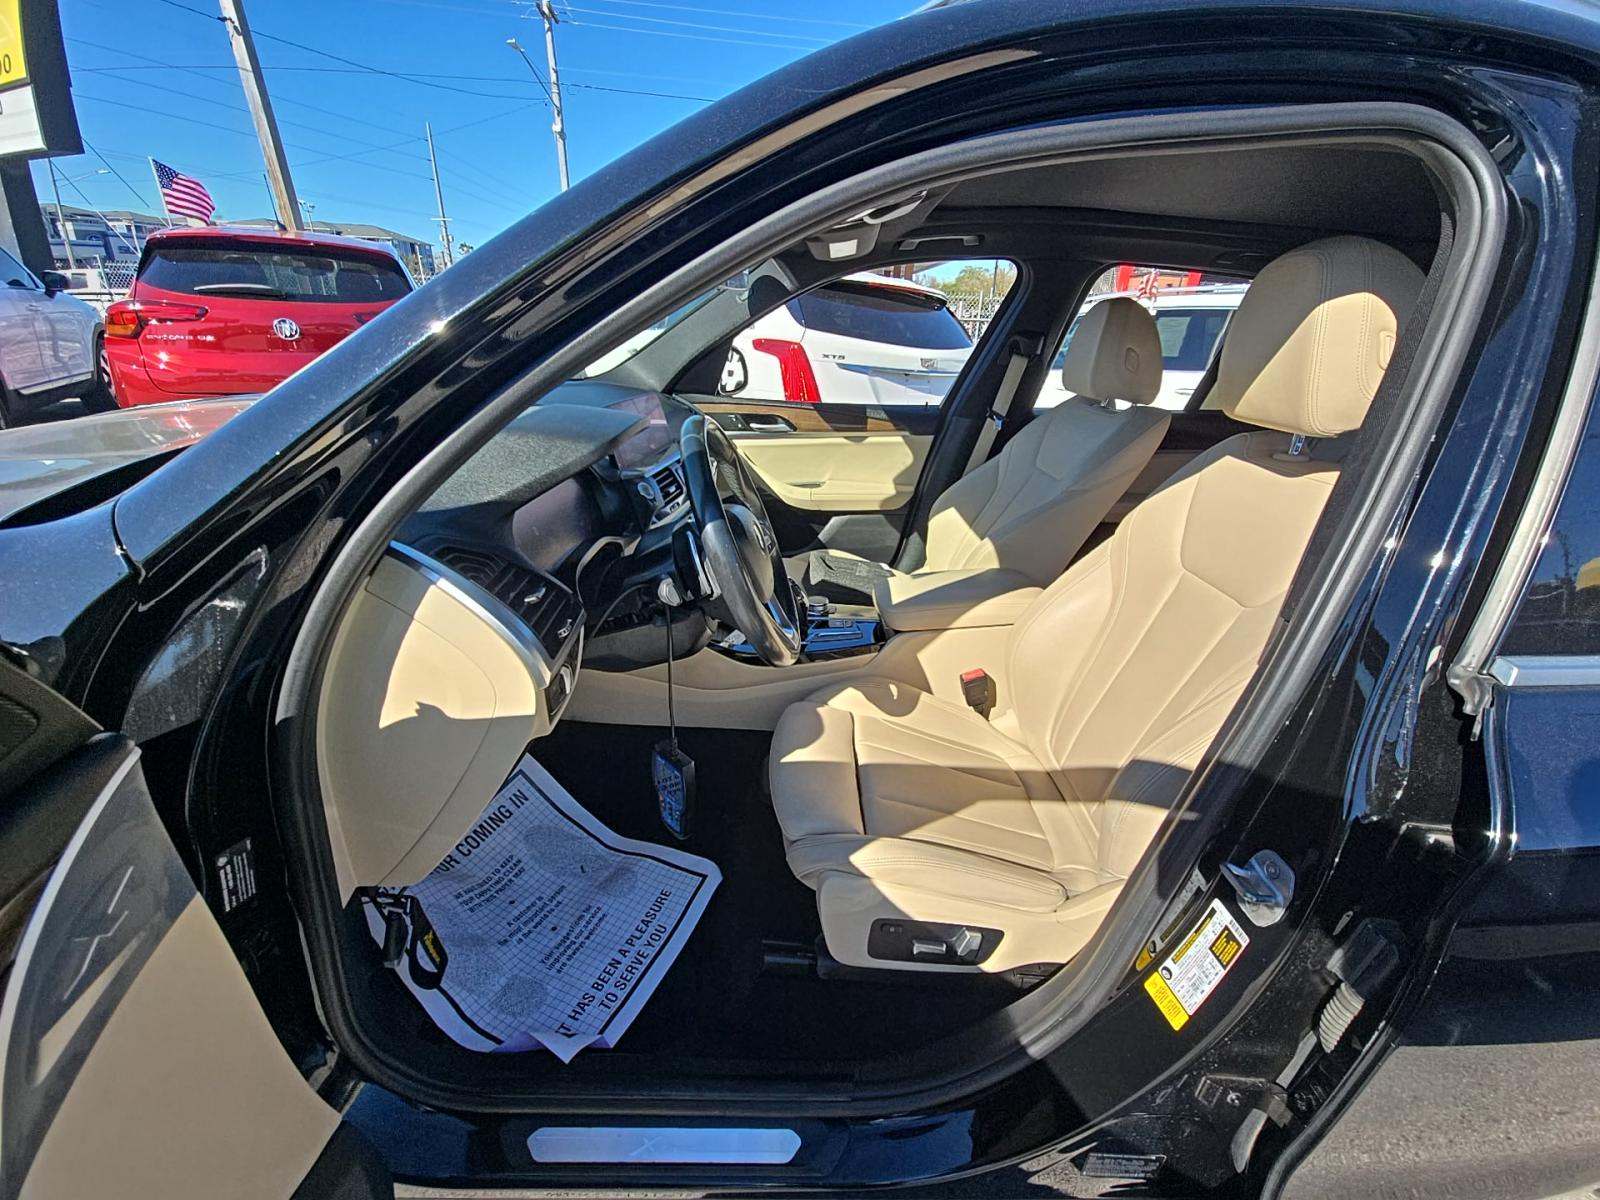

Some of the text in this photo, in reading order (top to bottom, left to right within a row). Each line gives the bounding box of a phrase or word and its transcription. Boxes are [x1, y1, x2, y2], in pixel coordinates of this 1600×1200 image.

[454, 802, 513, 859] COMING
[508, 788, 529, 809] IN
[568, 991, 596, 1022] HAS
[591, 956, 622, 993] BEEN
[617, 945, 630, 958] A
[625, 886, 672, 948] PLEASURE
[598, 922, 667, 1012] TO SERVE YOU
